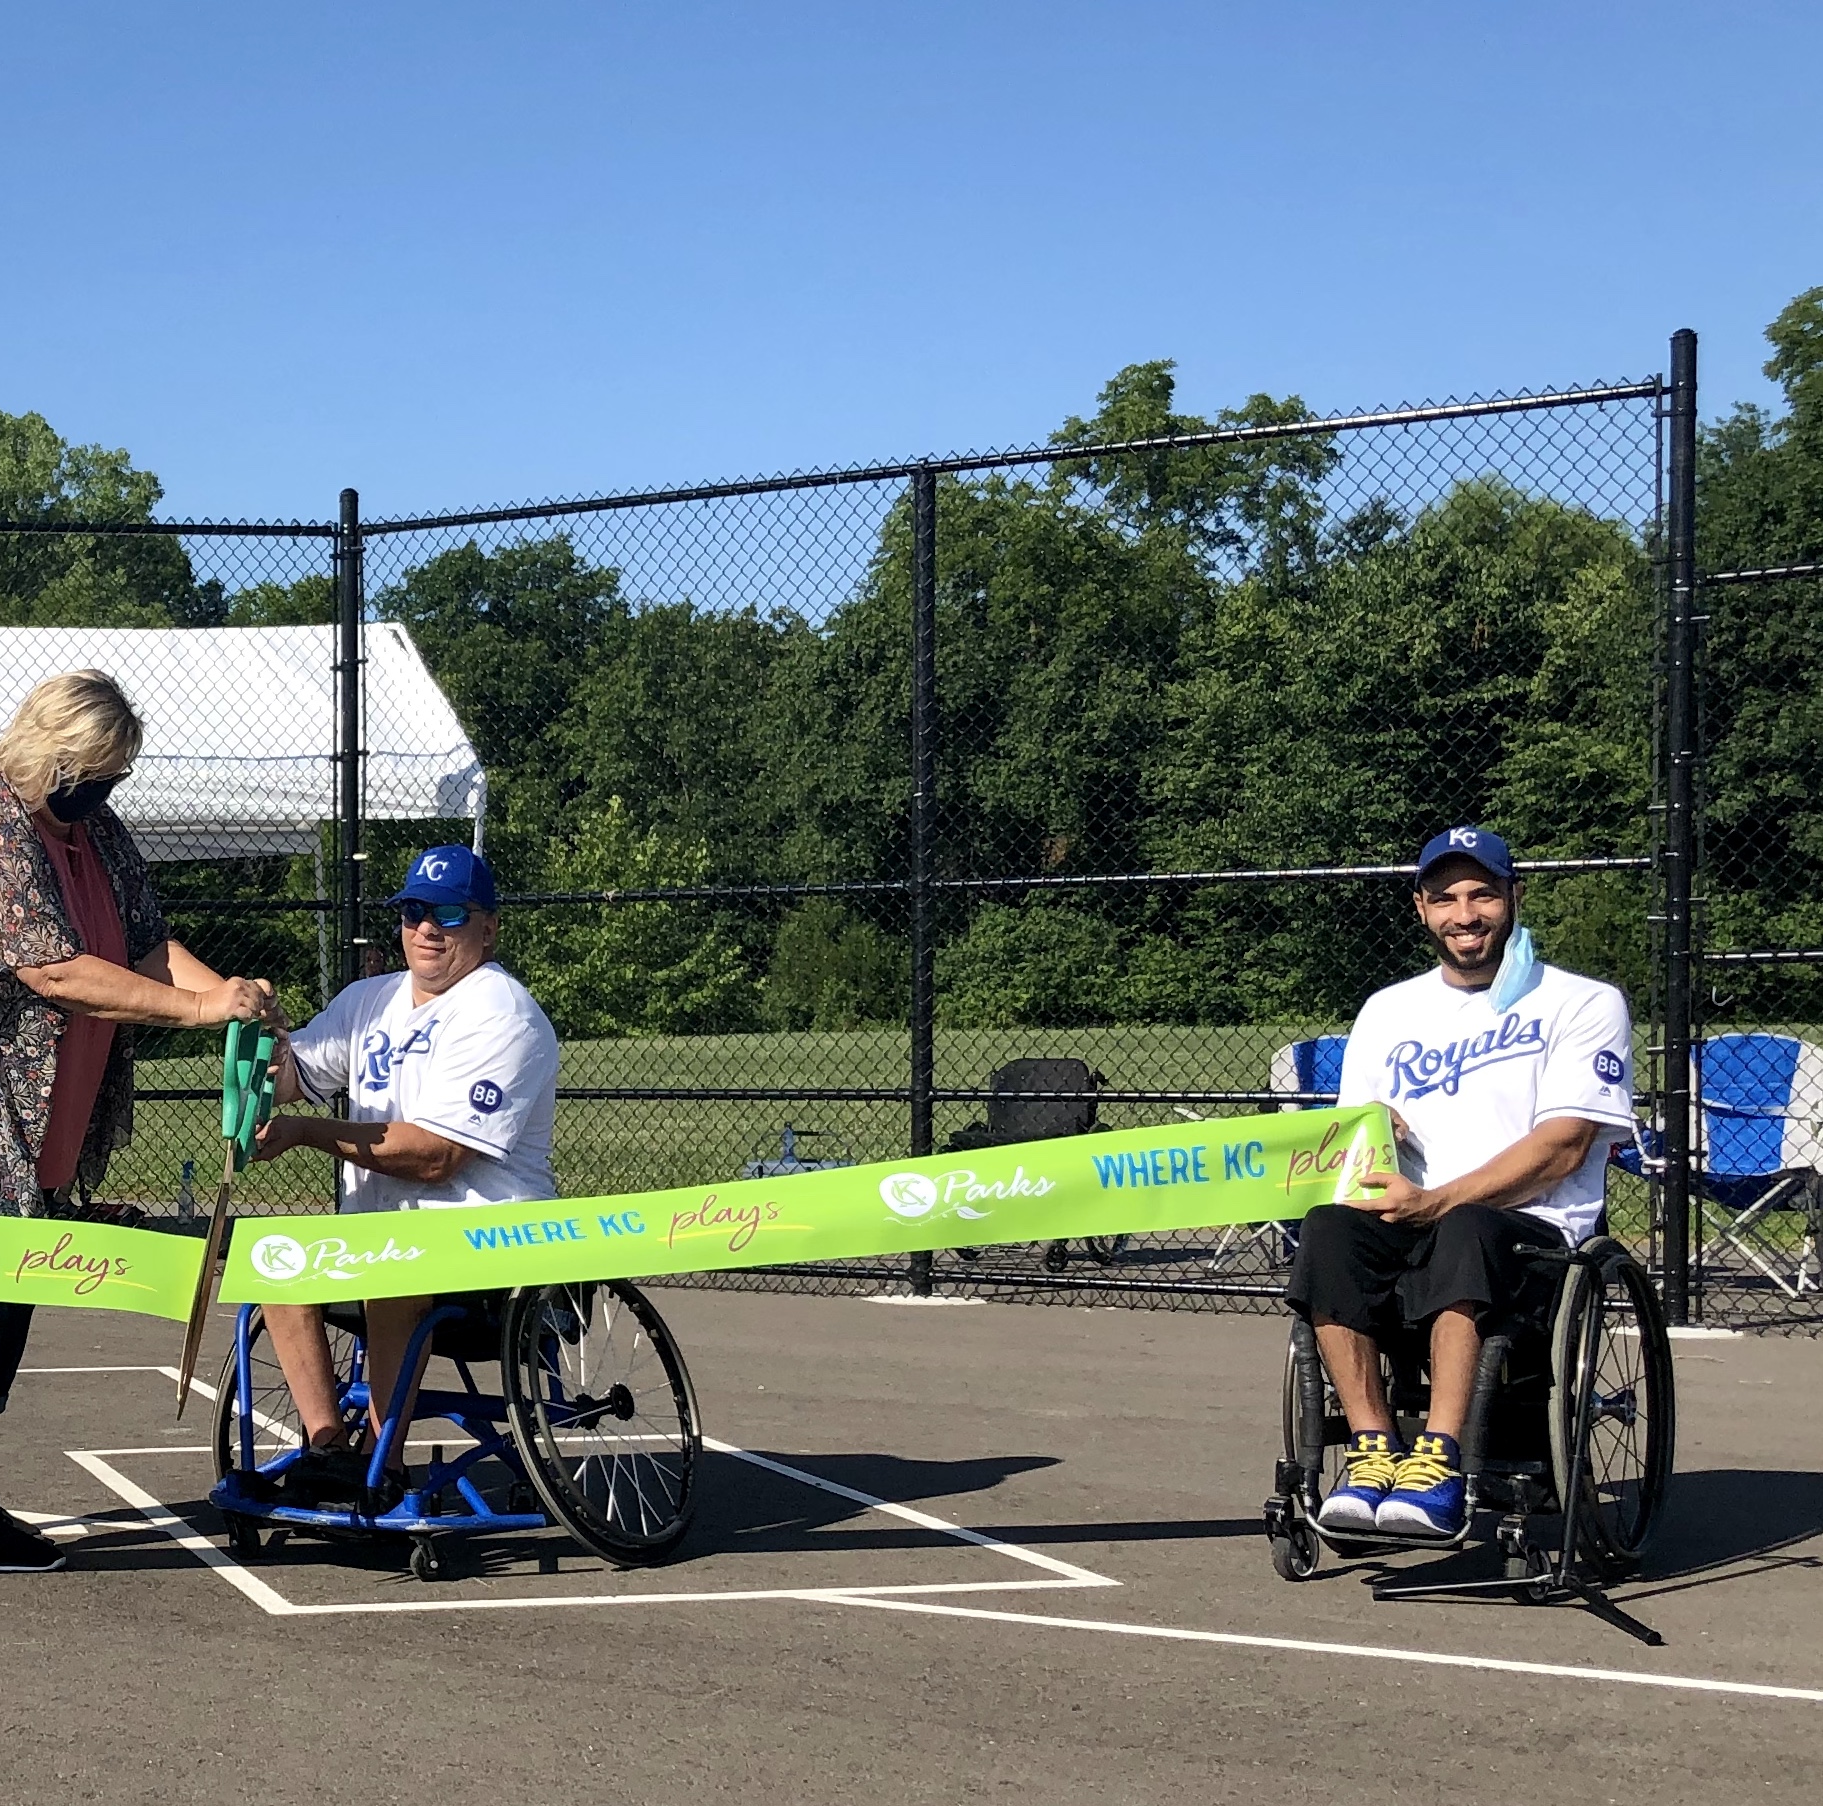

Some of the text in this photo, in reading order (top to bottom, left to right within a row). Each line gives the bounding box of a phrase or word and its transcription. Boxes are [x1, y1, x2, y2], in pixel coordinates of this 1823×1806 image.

[1449, 827, 1478, 849] KC
[416, 853, 448, 882] KC
[1385, 1012, 1544, 1101] Royals
[1596, 1054, 1621, 1078] BB
[472, 1084, 498, 1106] BB
[1091, 1120, 1395, 1198] WHERE KC plays
[933, 1165, 1057, 1204] Parks
[463, 1193, 784, 1253] WHERE KC plays
[16, 1232, 134, 1295] plays
[305, 1237, 426, 1270] Parks
